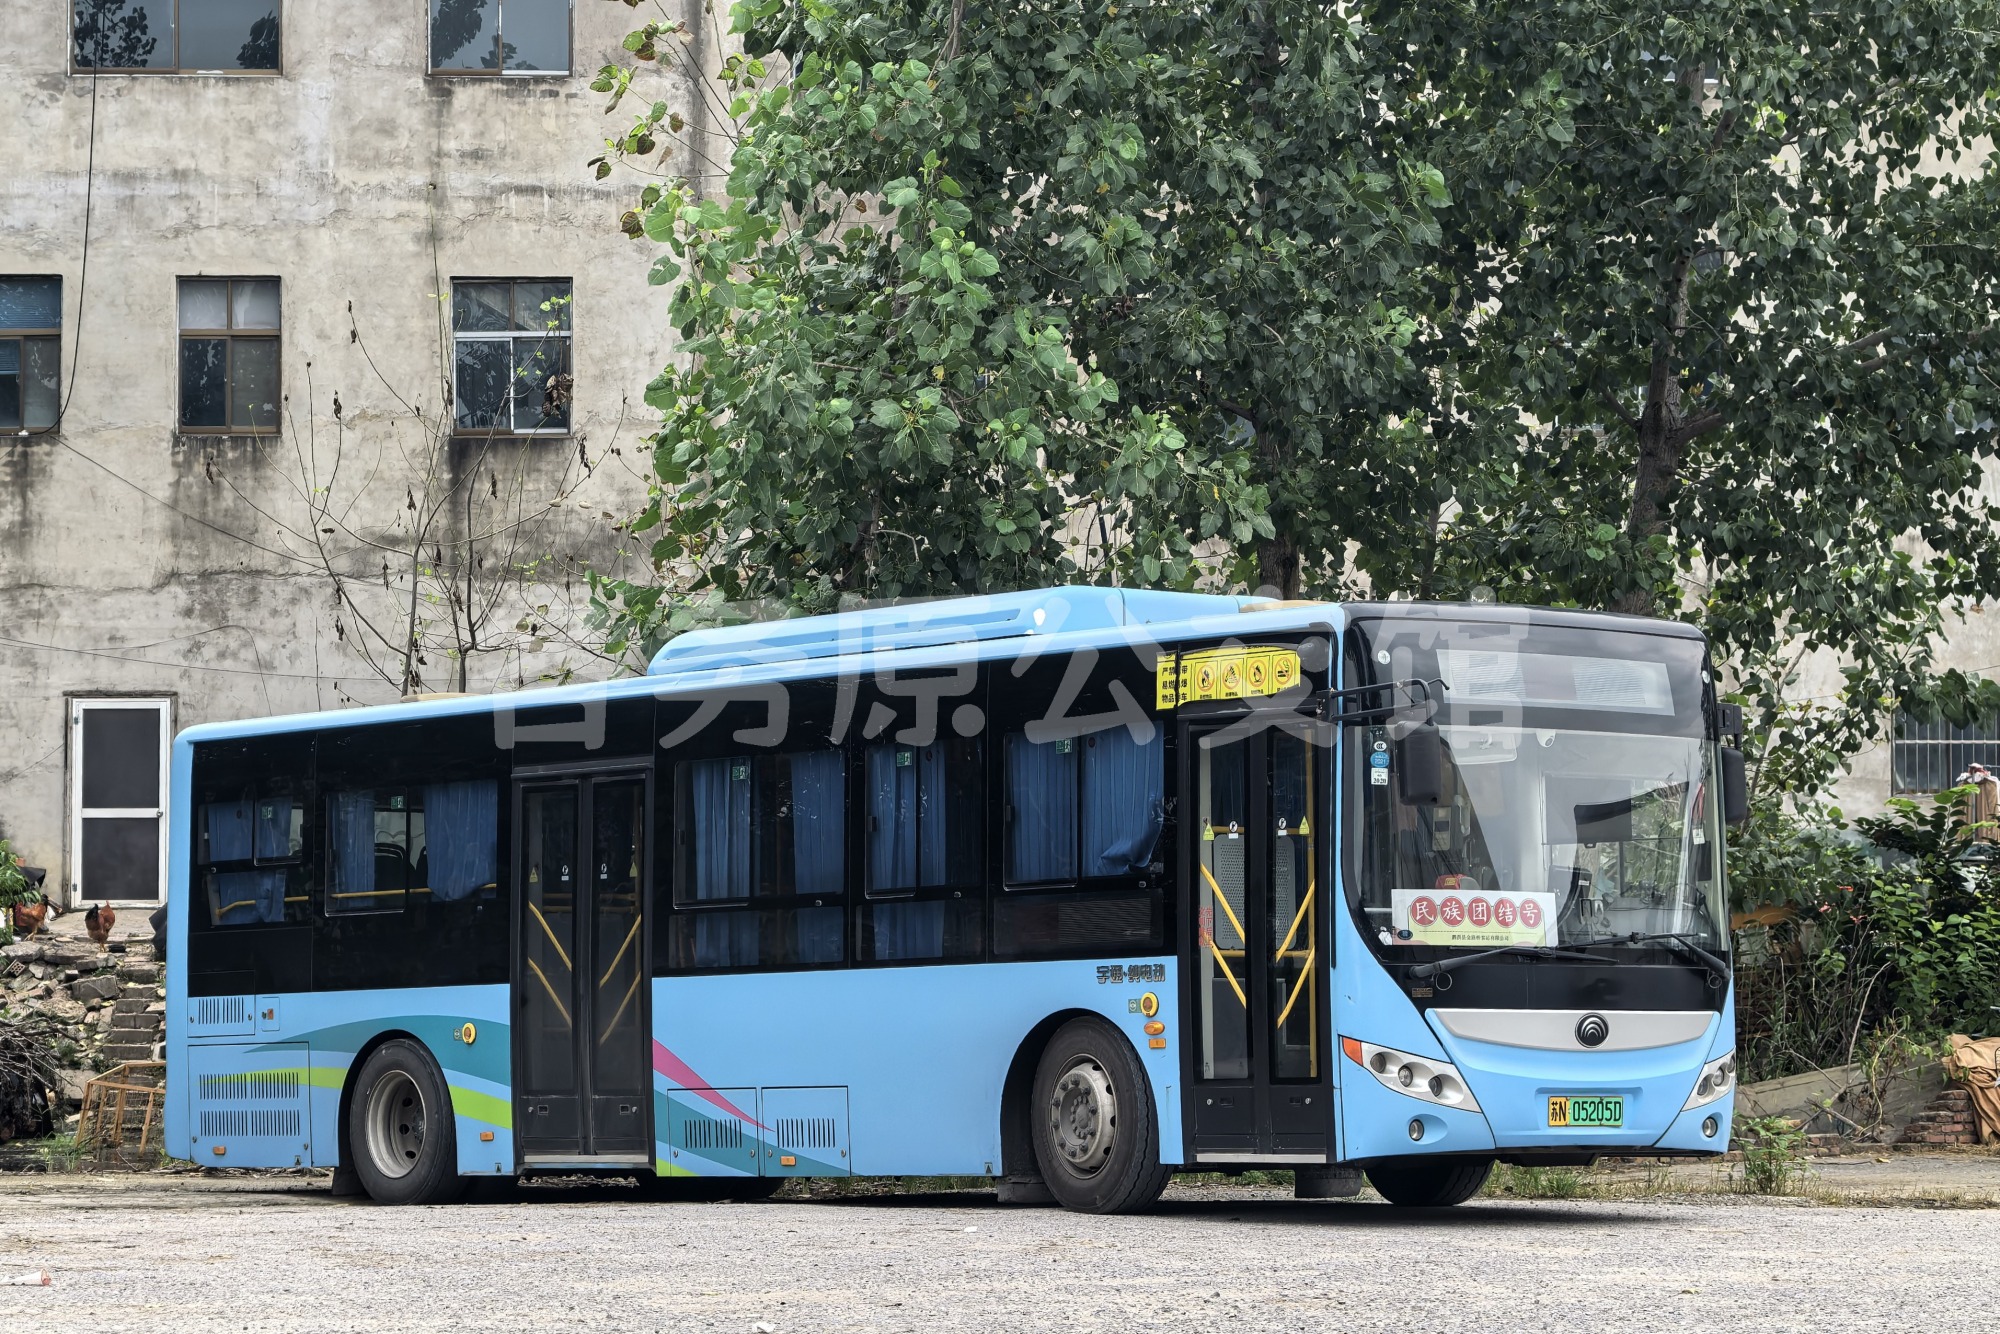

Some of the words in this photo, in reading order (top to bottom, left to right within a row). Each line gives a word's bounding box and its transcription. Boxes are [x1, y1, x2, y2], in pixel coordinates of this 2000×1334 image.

[1162, 665, 1187, 676] 严禁带
[1414, 900, 1539, 925] 民族团结号
